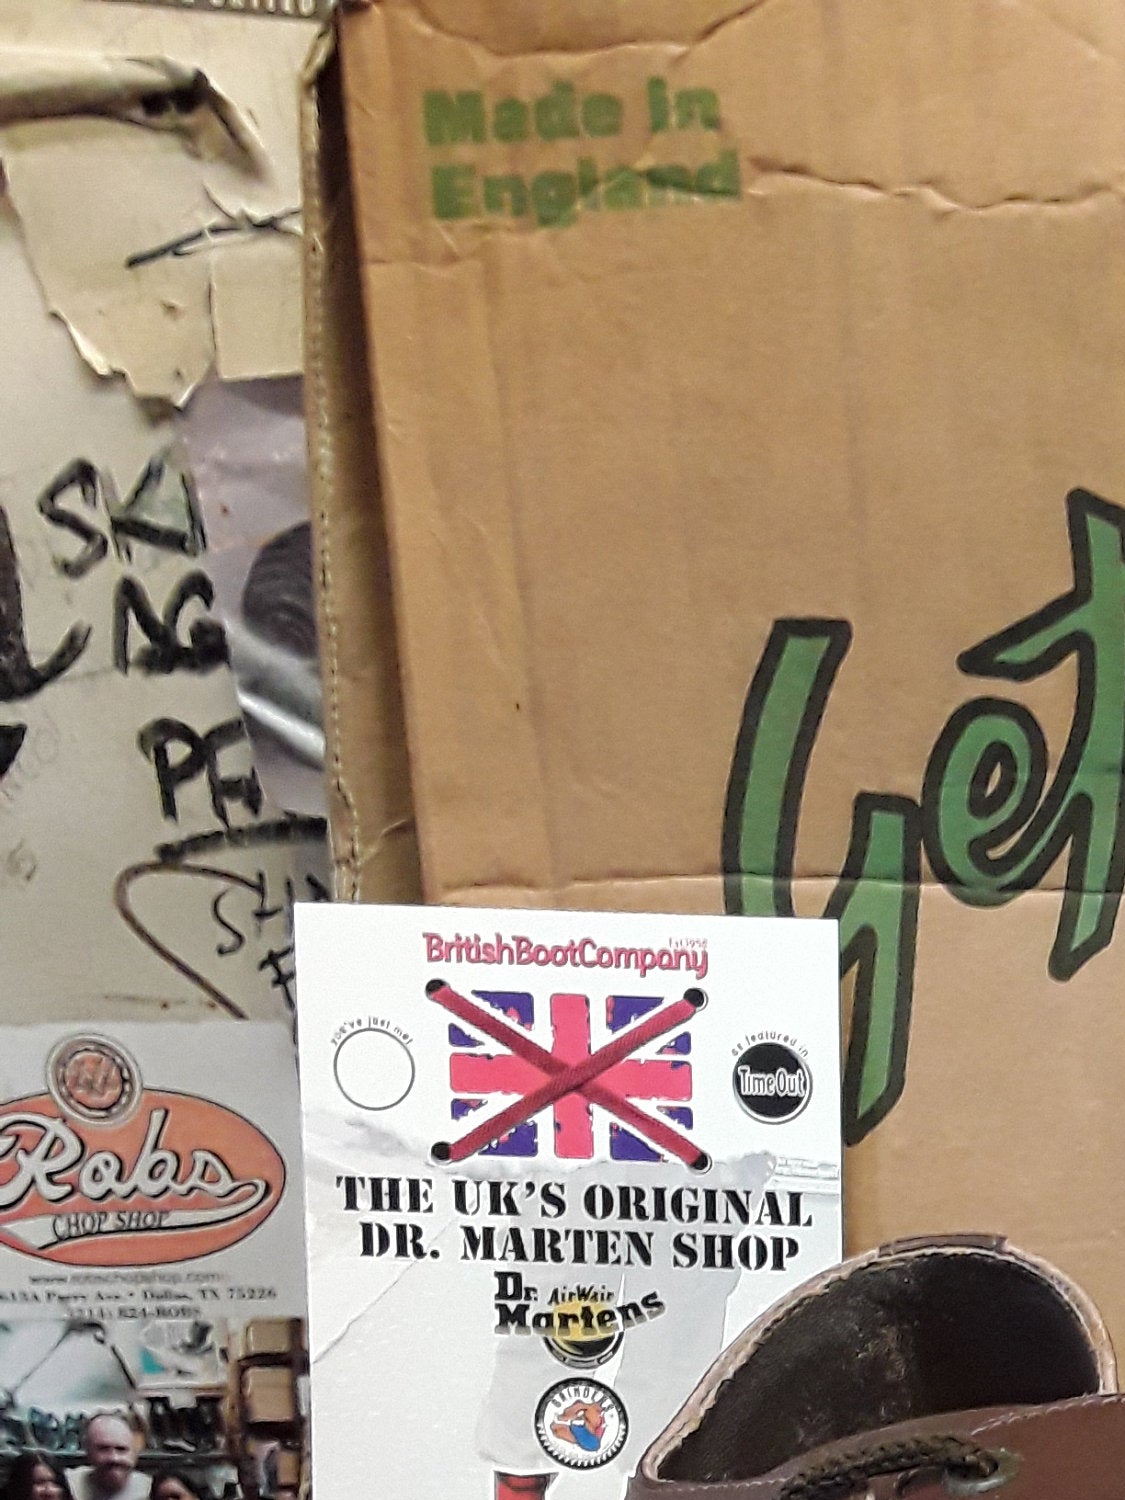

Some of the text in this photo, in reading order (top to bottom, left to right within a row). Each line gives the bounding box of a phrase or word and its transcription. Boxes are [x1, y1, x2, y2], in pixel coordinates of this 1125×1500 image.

[422, 80, 624, 148] Made
[431, 150, 744, 228] England
[423, 931, 709, 980] BritishBootCompany
[745, 1030, 798, 1047] featured
[336, 1174, 813, 1227] THE UK'S ORIGINAL
[53, 1211, 169, 1240] CHOP SHOP
[360, 1222, 800, 1271] DR. MARTEN SHOP
[494, 1271, 538, 1301] Dr.
[547, 1284, 615, 1306] AirWair
[494, 1291, 668, 1336] Martens
